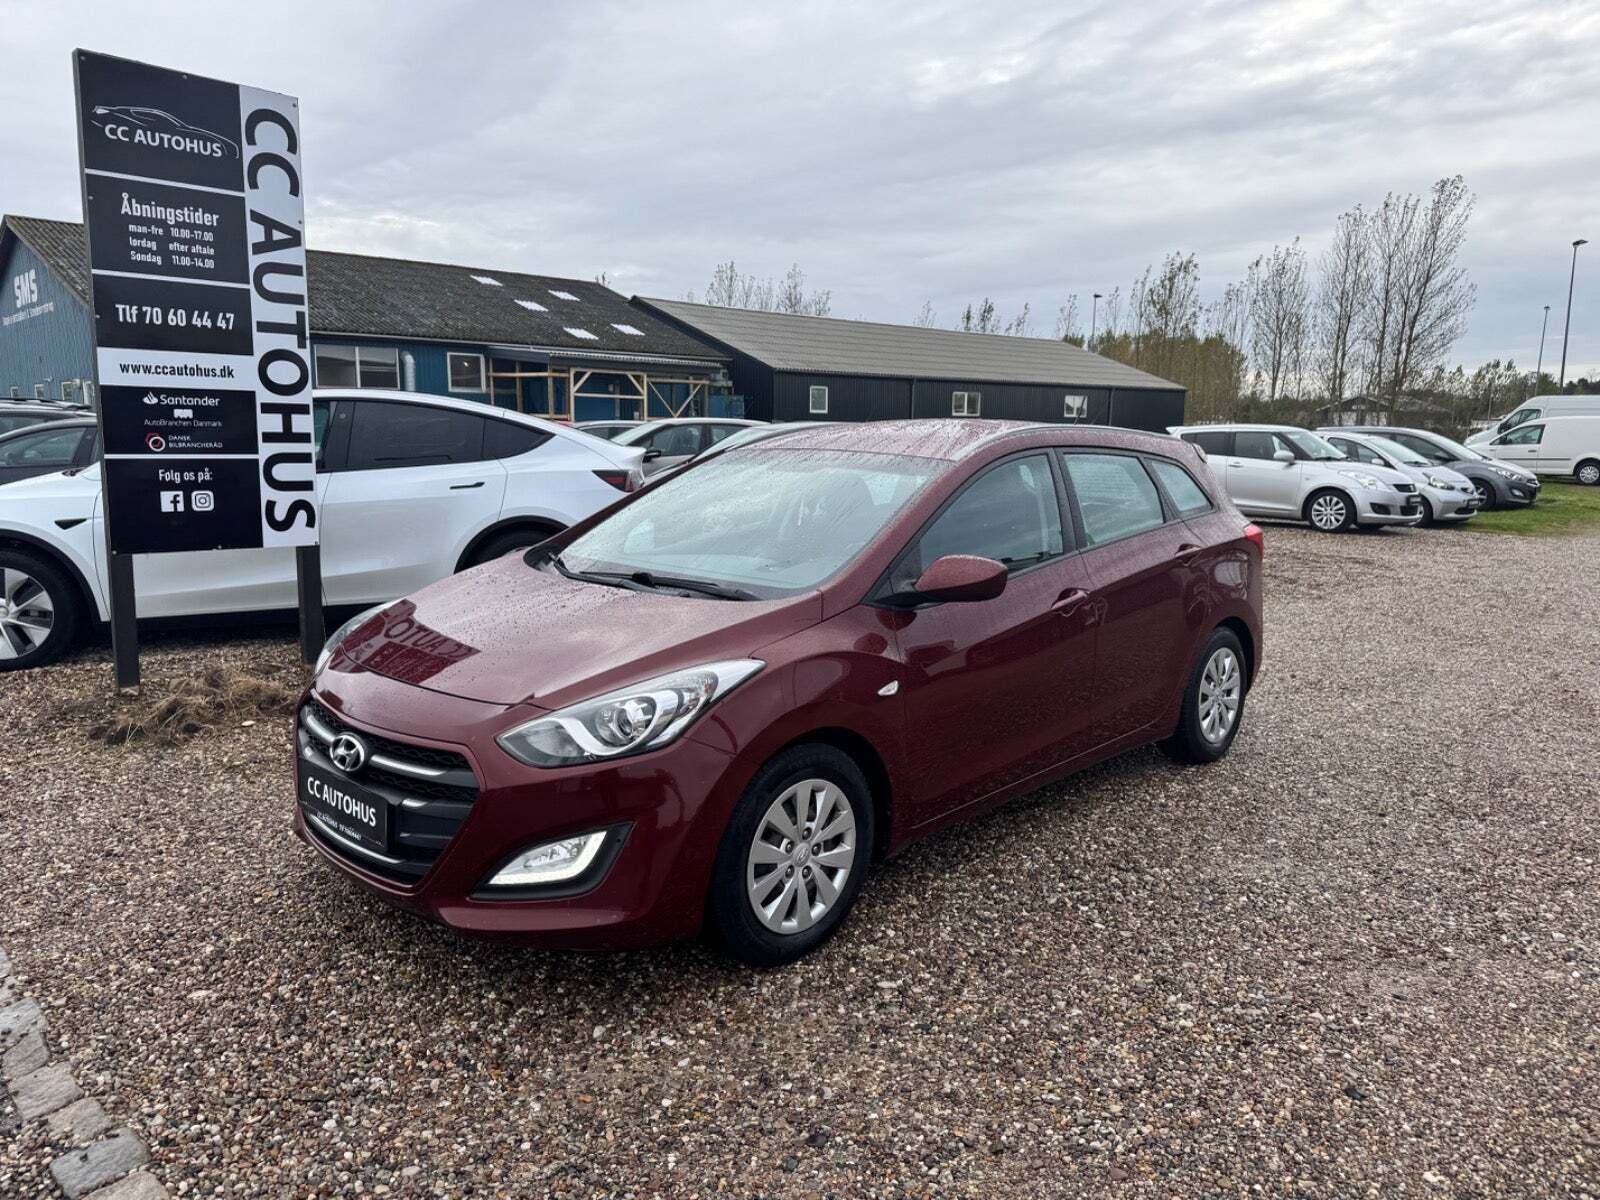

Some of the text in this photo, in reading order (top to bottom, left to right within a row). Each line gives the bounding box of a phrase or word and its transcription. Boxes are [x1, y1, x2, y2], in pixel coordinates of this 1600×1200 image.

[104, 123, 223, 158] CC AUTOHUS
[120, 192, 220, 226] Åbningstider
[128, 224, 214, 242] man-fre 10.00-17.00
[168, 241, 188, 252] efter
[191, 244, 215, 255] aftale
[172, 255, 215, 269] 11.00-14.00
[13, 268, 38, 309] SMS
[115, 304, 235, 330] Tlf 70 60 44 47
[244, 107, 316, 532] CC AUTOHUS
[119, 361, 235, 379] www.ccautohus.dk
[159, 394, 220, 406] Santander
[158, 467, 213, 484] Følg os på:
[307, 776, 322, 797] CC
[322, 785, 377, 828] AUTOHUS
